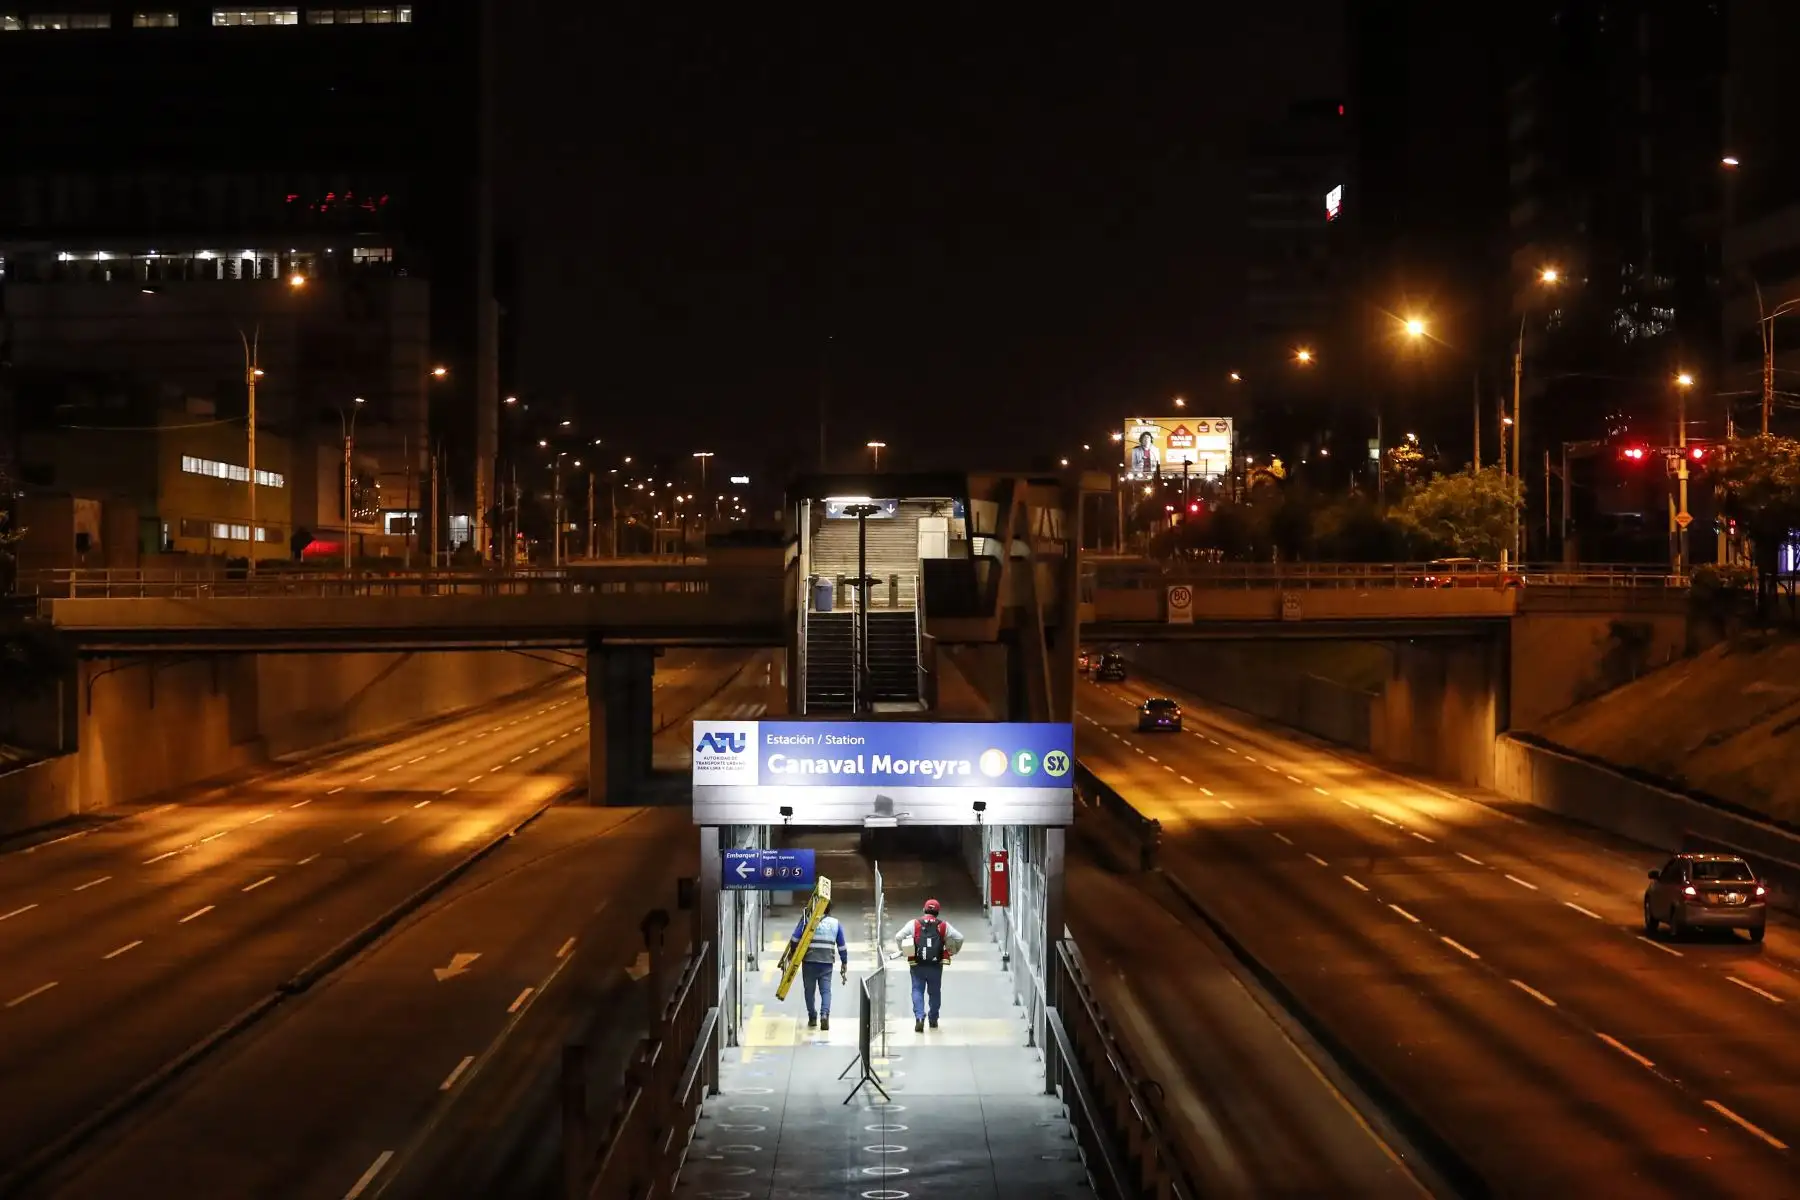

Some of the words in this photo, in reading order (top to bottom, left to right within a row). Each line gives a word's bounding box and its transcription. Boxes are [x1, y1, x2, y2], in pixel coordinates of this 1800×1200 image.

[696, 732, 746, 753] ATU
[767, 734, 815, 745] Estación
[817, 734, 822, 745] /
[825, 734, 865, 745] Station
[767, 753, 865, 774] Canaval
[872, 754, 971, 780] Moreyra
[1018, 752, 1032, 774] C
[1047, 755, 1066, 772] SX
